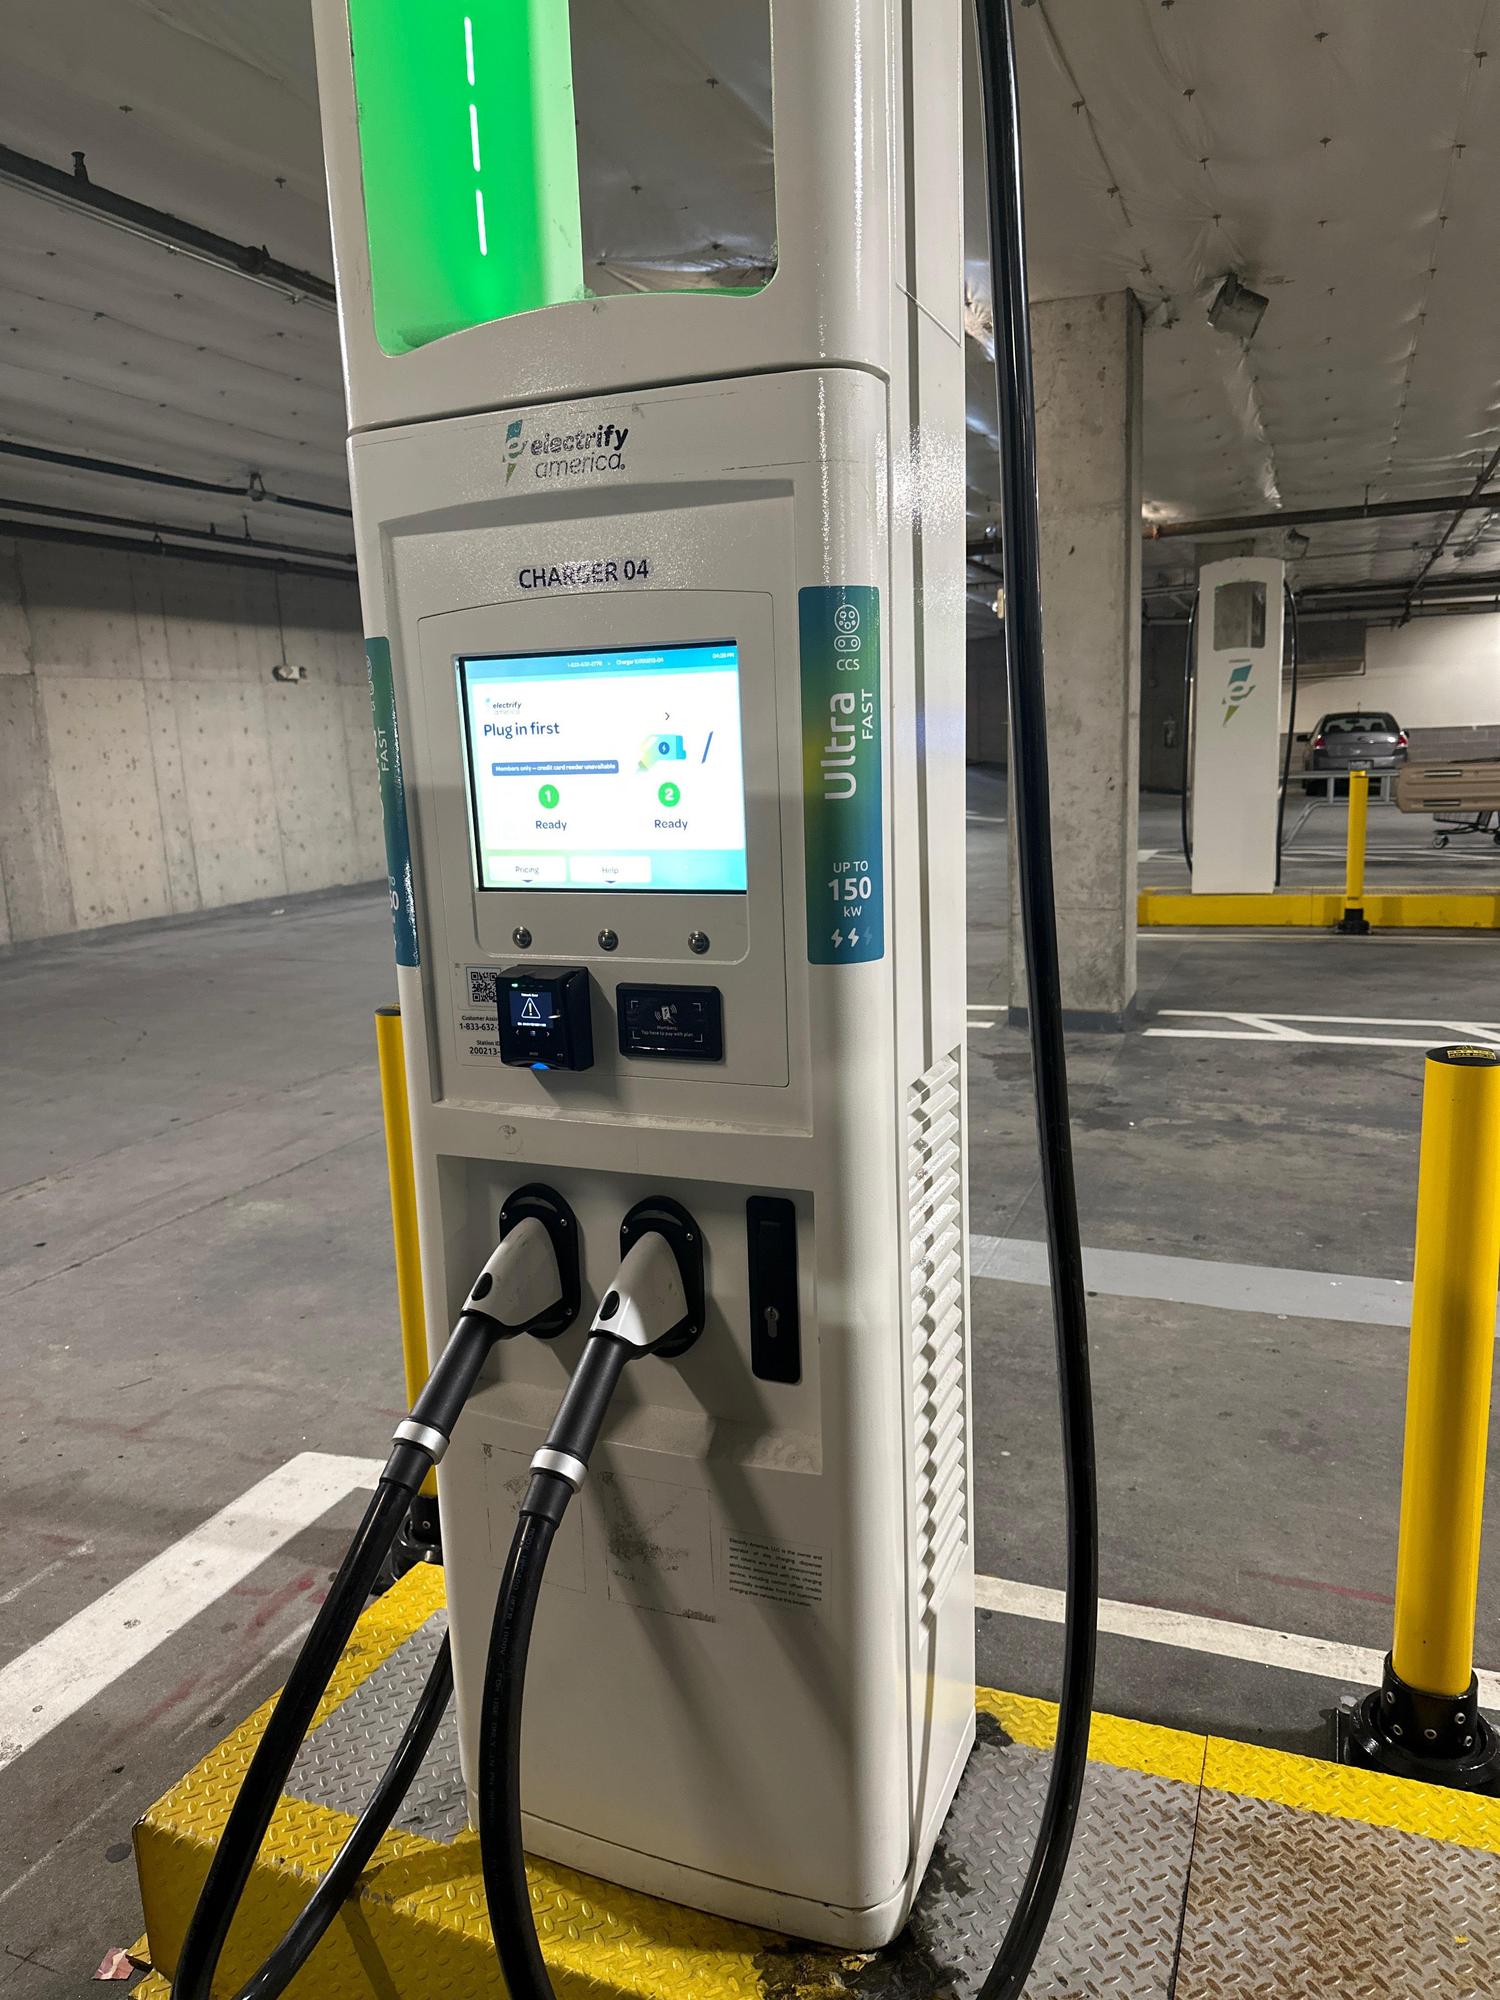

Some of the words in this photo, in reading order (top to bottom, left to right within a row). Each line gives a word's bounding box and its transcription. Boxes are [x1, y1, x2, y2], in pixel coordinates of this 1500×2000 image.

[531, 424, 629, 456] electrify
[519, 562, 618, 588] CHARGER
[623, 559, 649, 580] 04
[836, 658, 861, 671] CCS
[492, 701, 522, 710] electrify
[861, 688, 874, 741] FAST
[483, 723, 513, 740] Plug
[515, 721, 528, 736] in
[530, 721, 560, 736] first
[377, 727, 391, 772] FAST
[820, 691, 857, 801] Ultra
[535, 819, 567, 831] Ready
[654, 818, 688, 831] Ready
[515, 865, 540, 875] Pricing
[602, 866, 619, 875] Help
[833, 861, 850, 873] UP
[853, 860, 869, 872] TO
[828, 876, 872, 902] 150
[843, 906, 862, 918] kW
[459, 1022, 500, 1031] 1-833-632-
